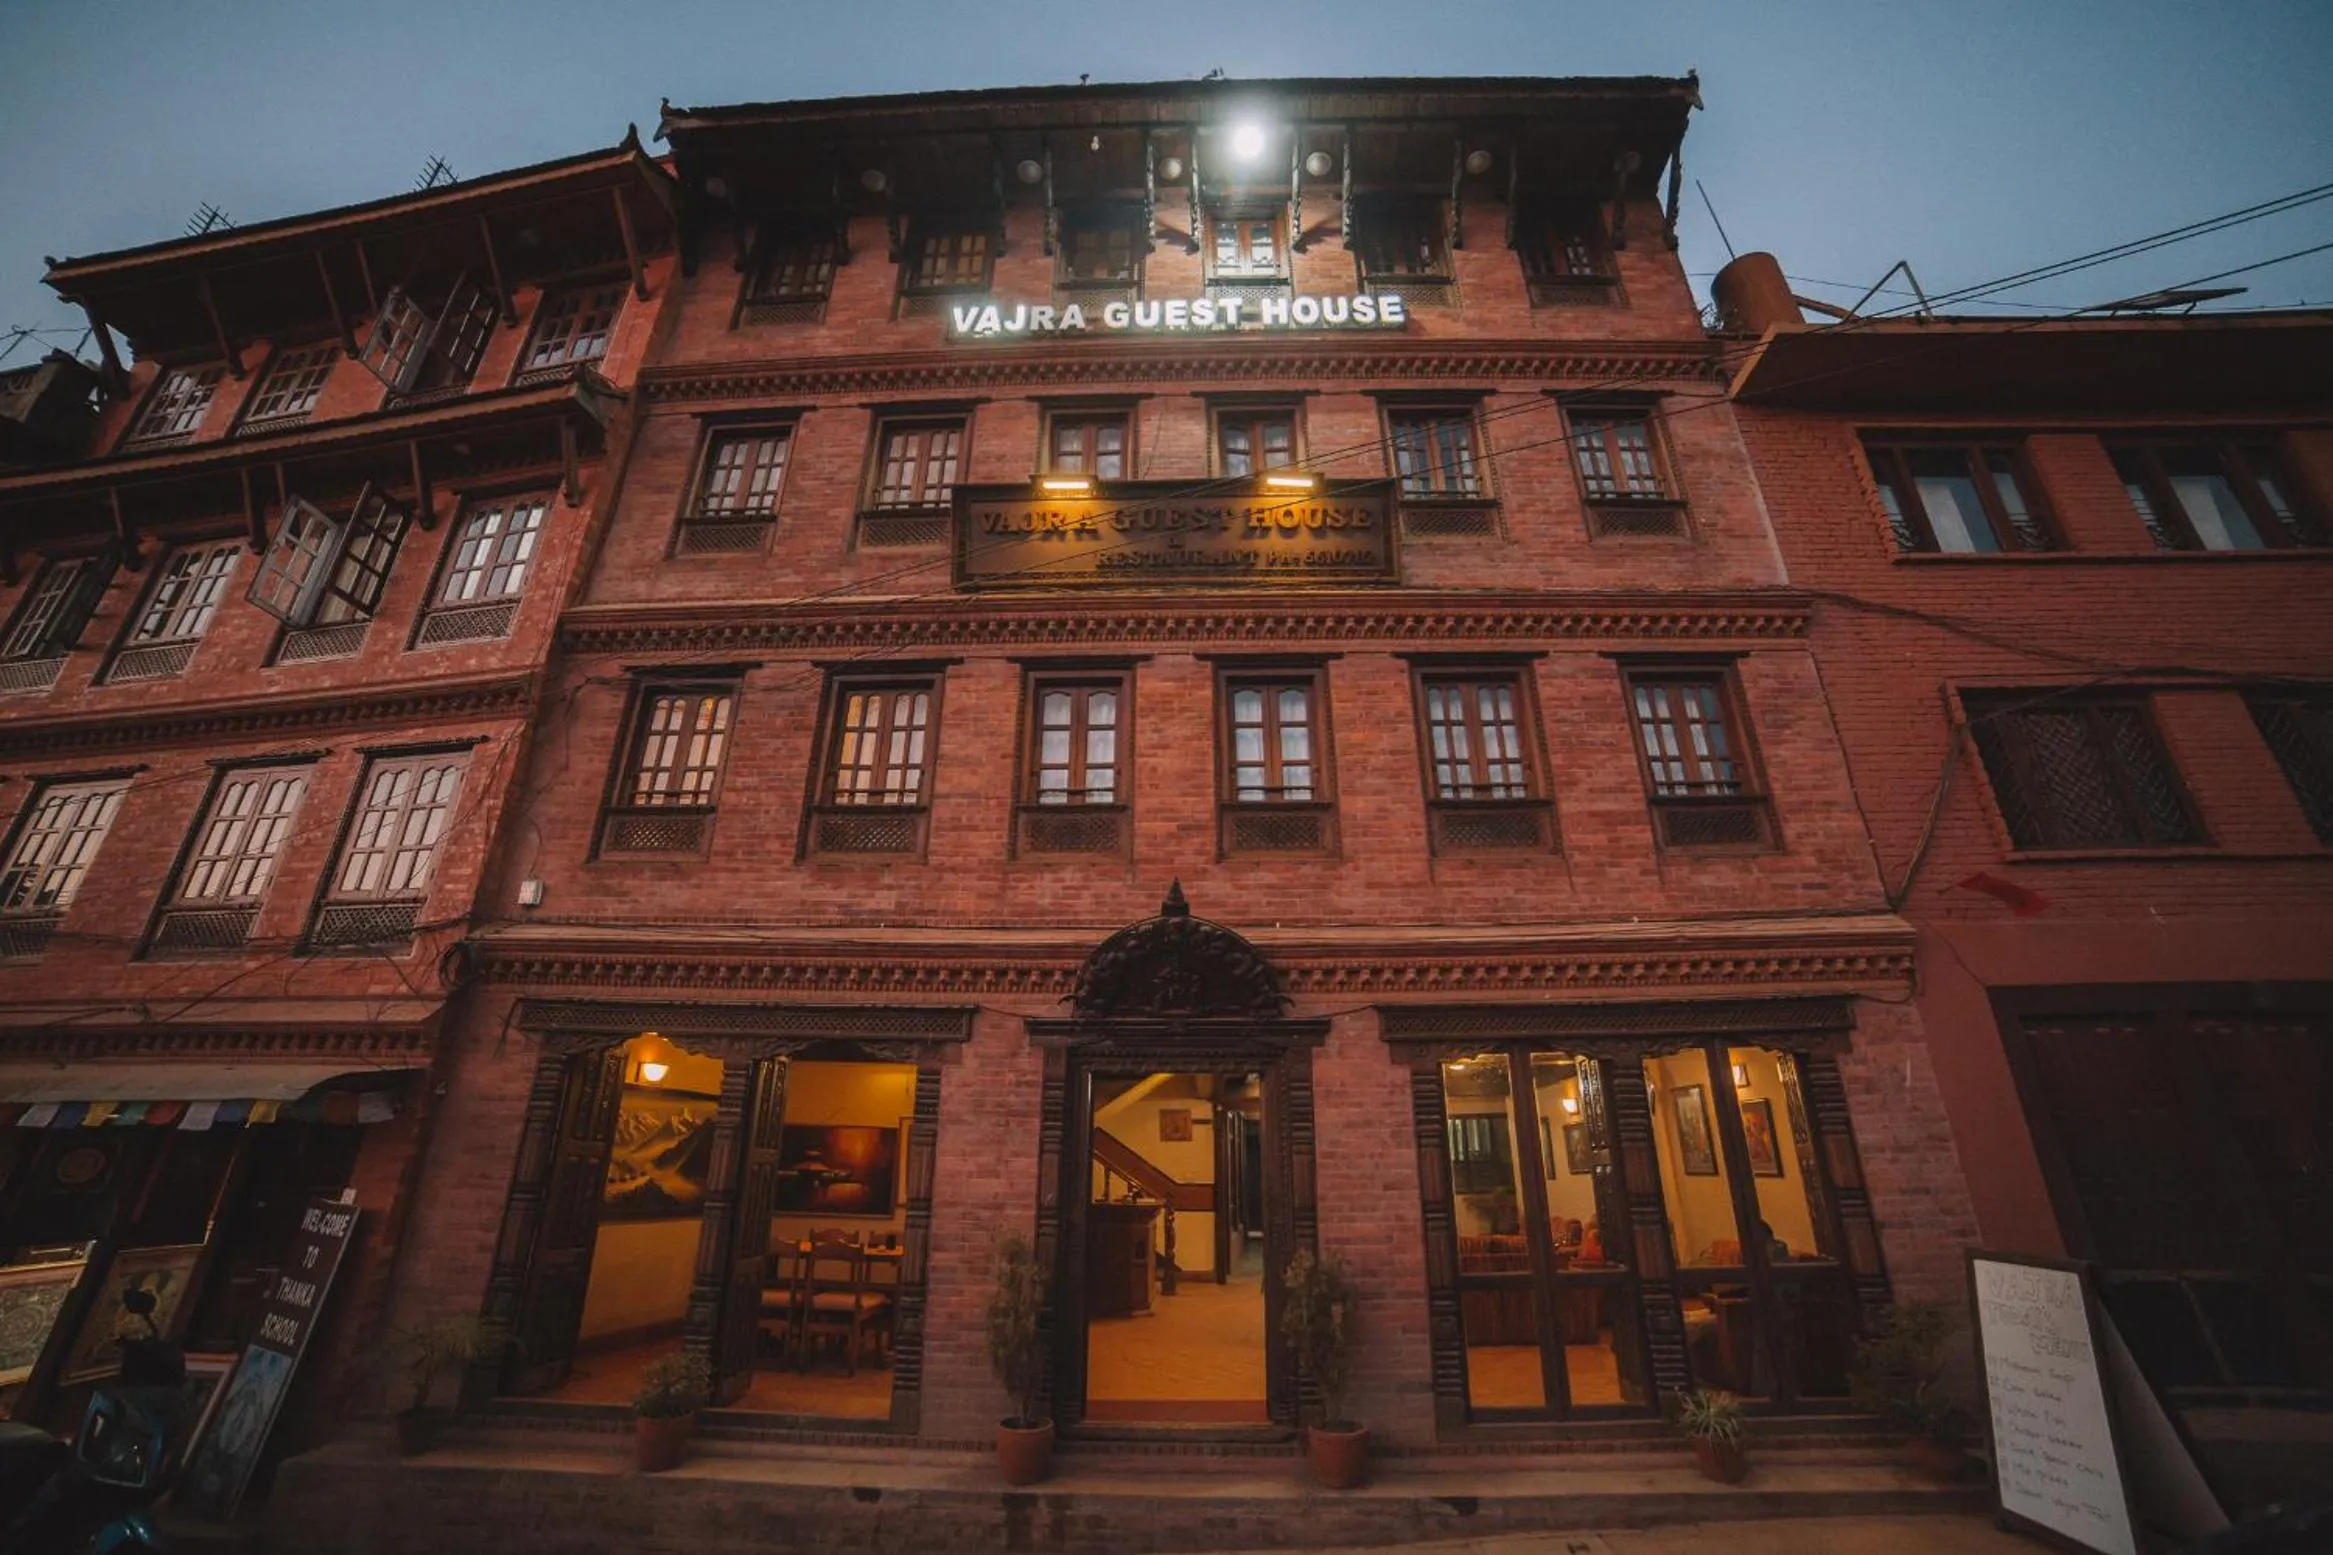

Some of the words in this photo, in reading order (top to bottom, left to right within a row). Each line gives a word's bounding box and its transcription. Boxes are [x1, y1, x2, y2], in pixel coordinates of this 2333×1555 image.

[952, 303, 1087, 333] VAJRA
[1103, 299, 1242, 328] GUEST
[1261, 295, 1405, 325] HOUSE
[981, 510, 1098, 535] VAJRA
[1110, 507, 1233, 532] GUEST
[1246, 506, 1373, 529] HOUSE
[1097, 550, 1258, 567] RESTAURANT
[302, 1208, 350, 1236] WELCOME
[303, 1245, 320, 1268] TO
[261, 1313, 299, 1345] SCHOOL
